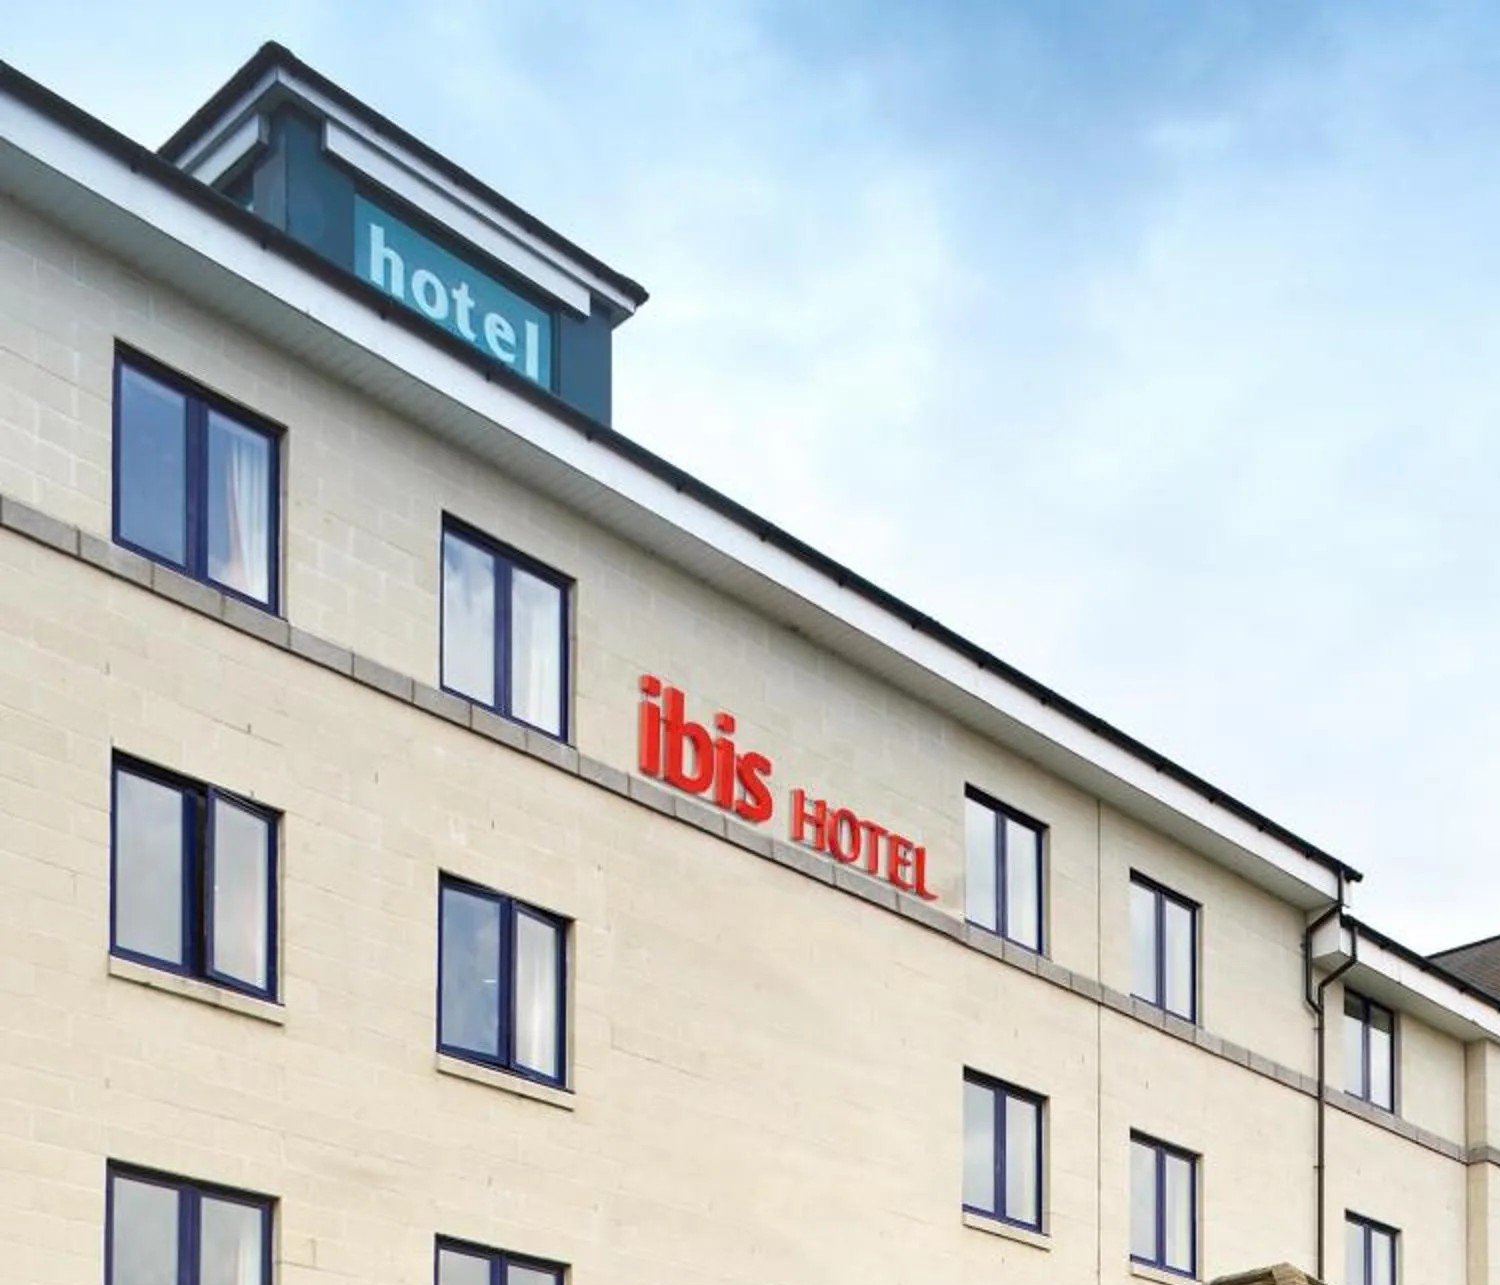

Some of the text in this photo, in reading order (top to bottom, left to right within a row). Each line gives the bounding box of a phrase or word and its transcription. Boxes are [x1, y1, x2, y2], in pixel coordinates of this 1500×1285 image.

[369, 223, 540, 384] hotel
[638, 673, 938, 901] ibis HOTEL
